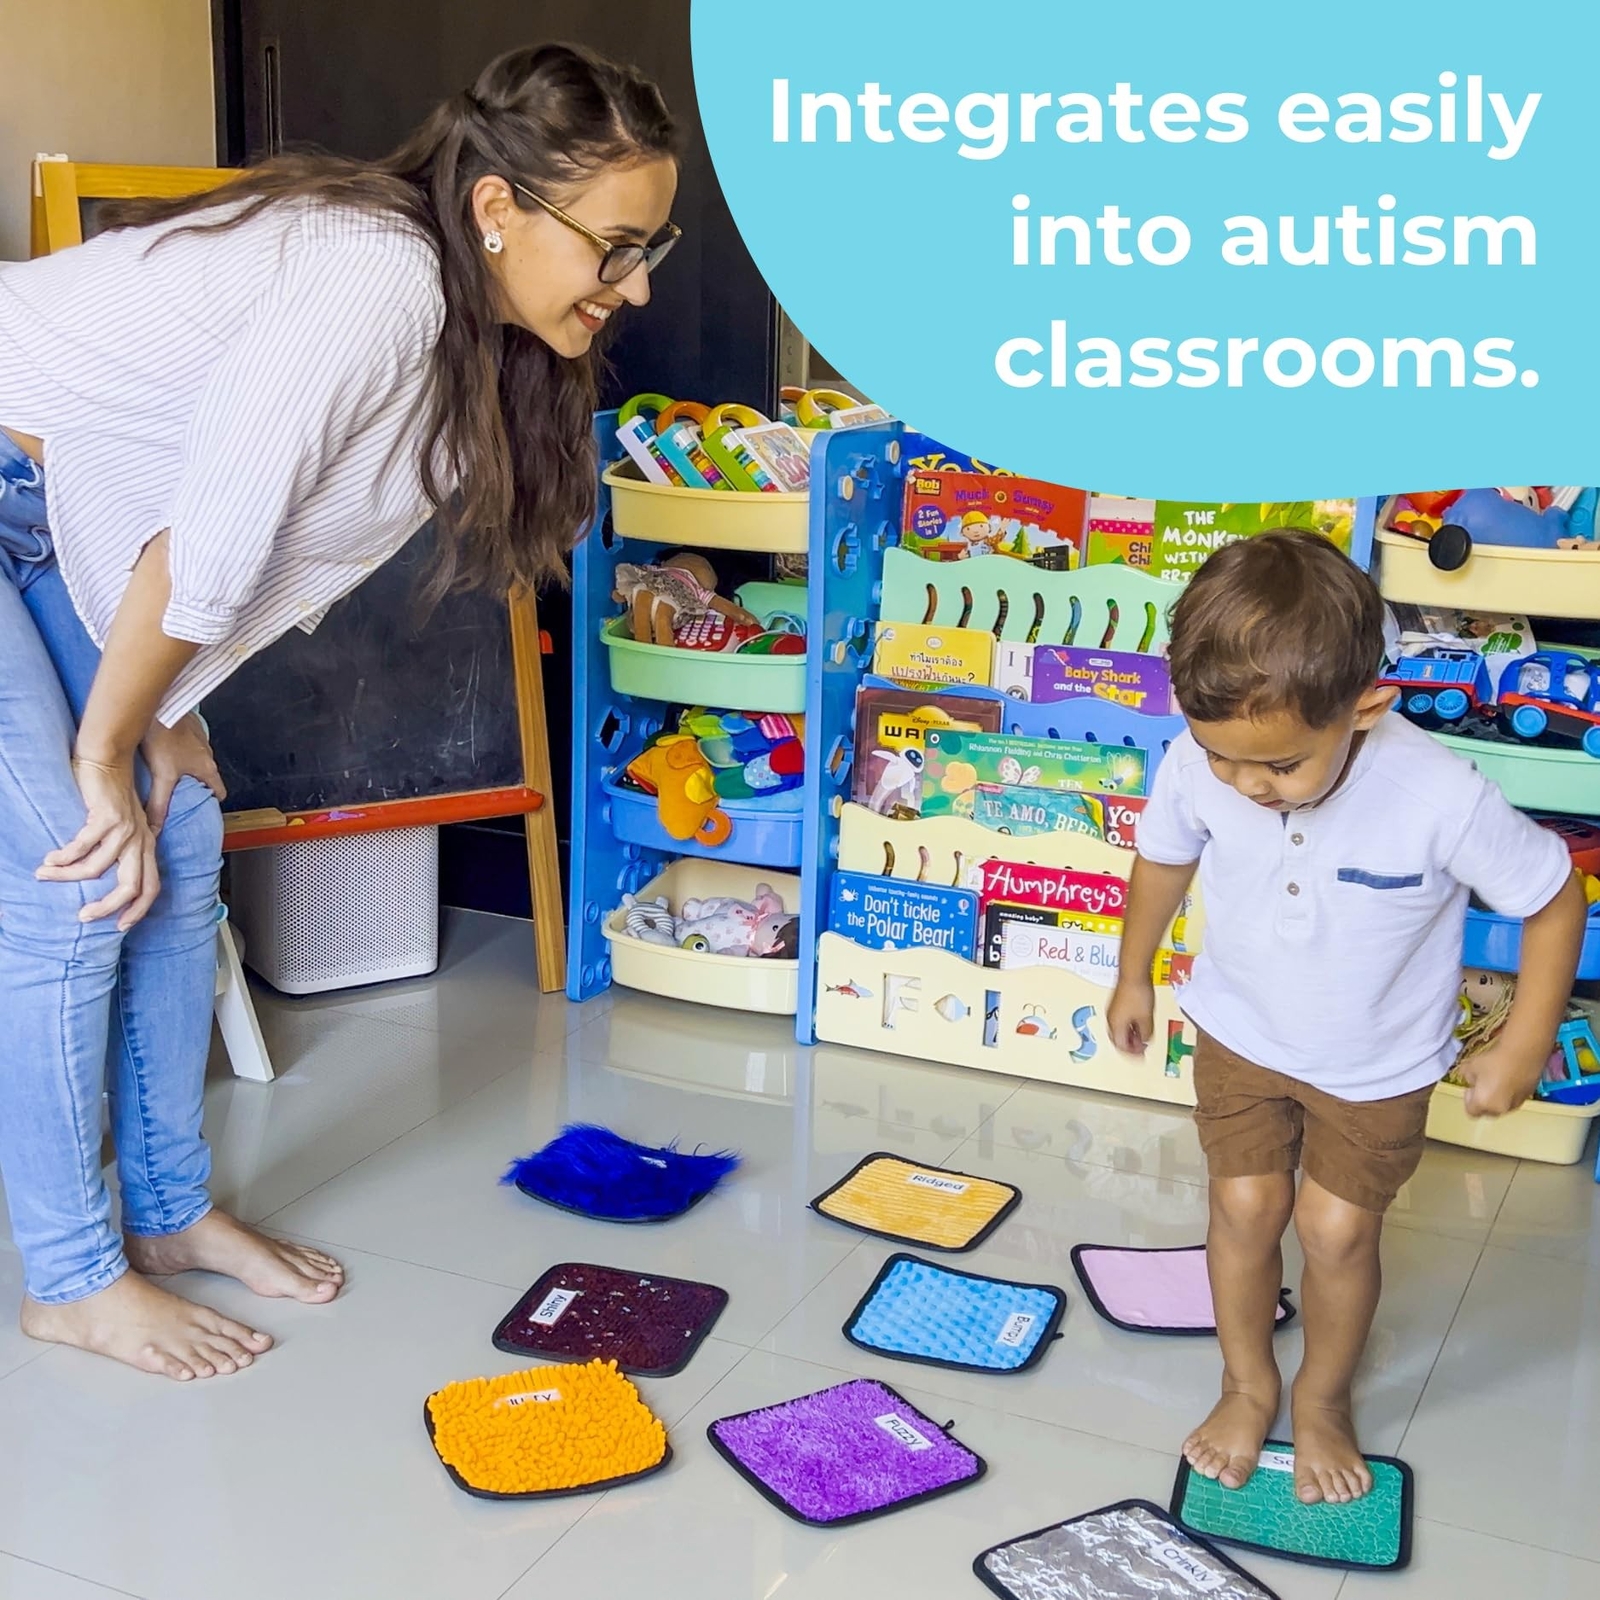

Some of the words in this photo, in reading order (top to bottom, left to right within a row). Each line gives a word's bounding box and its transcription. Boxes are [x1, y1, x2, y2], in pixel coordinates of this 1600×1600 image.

[917, 518, 943, 528] Stories
[918, 510, 924, 519] 2
[926, 510, 940, 518] Fun
[1183, 510, 1216, 526] THE
[1129, 541, 1152, 554] Chi
[1128, 554, 1151, 567] Chi
[1161, 569, 1192, 582] BRI
[1064, 666, 1099, 683] Baby
[1101, 670, 1141, 684] Shark
[1053, 682, 1073, 692] and
[1074, 684, 1092, 694] the
[1093, 682, 1147, 708] Star
[885, 726, 926, 740] WA
[984, 800, 1004, 817] TE
[1009, 803, 1049, 829] AMO,
[988, 865, 1123, 913] Humphrey's
[864, 894, 899, 916] Don't
[903, 900, 941, 923] tickle
[999, 911, 1024, 920] amazing
[847, 912, 865, 927] the
[867, 914, 908, 940] Polar
[913, 921, 955, 949] Bear!
[1038, 937, 1070, 962] Red
[1075, 946, 1084, 963] &
[1090, 944, 1119, 968] Blu
[913, 1175, 964, 1190] Ridged
[540, 1294, 567, 1318] Shiny
[1003, 1316, 1030, 1343] Bumpy
[884, 1419, 922, 1445] Fuzzy
[1163, 1548, 1214, 1582] Crinkly
